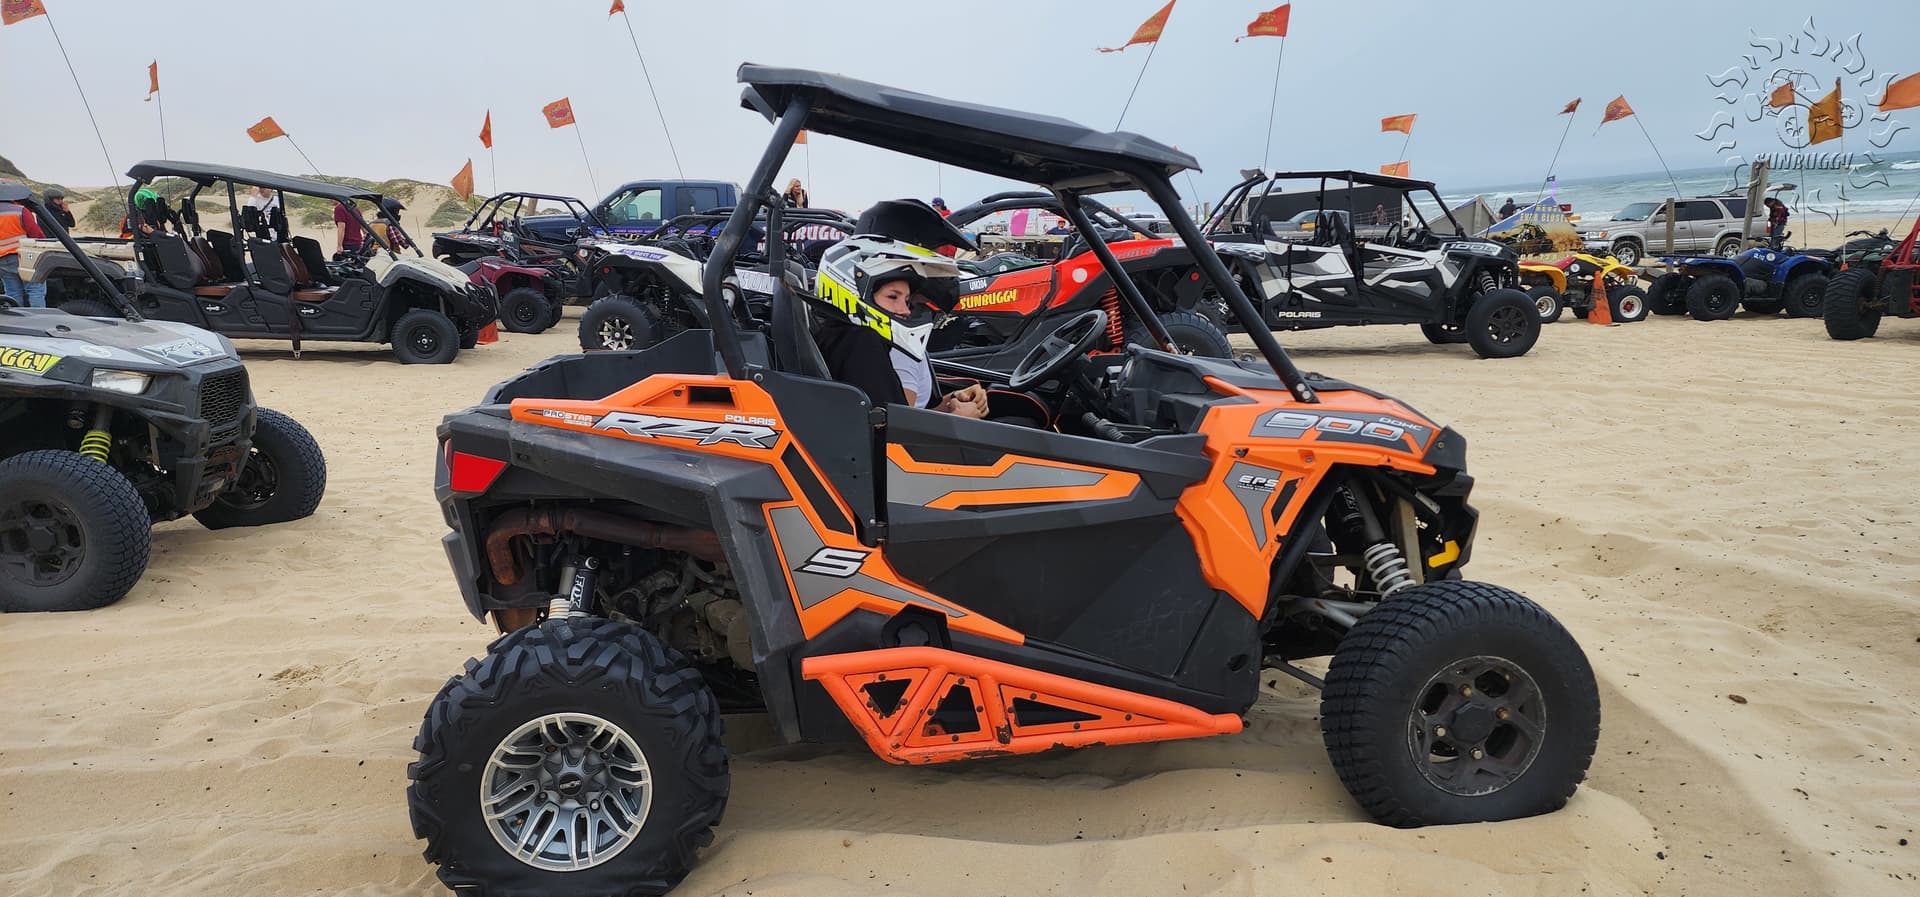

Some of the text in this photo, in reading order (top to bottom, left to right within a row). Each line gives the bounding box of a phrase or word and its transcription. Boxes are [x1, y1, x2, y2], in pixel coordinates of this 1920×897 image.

[1373, 253, 1411, 264] XP
[959, 288, 1018, 310] SUNBUGGY
[1279, 311, 1322, 319] POLARIS
[543, 409, 593, 423] PROSTAR
[725, 414, 777, 426] POLARIS
[1379, 416, 1424, 432] DOHC
[592, 410, 778, 449] RZR
[1264, 410, 1405, 442] 900
[1239, 474, 1280, 488] EPS
[799, 546, 871, 578] S
[570, 574, 586, 609] FOX
